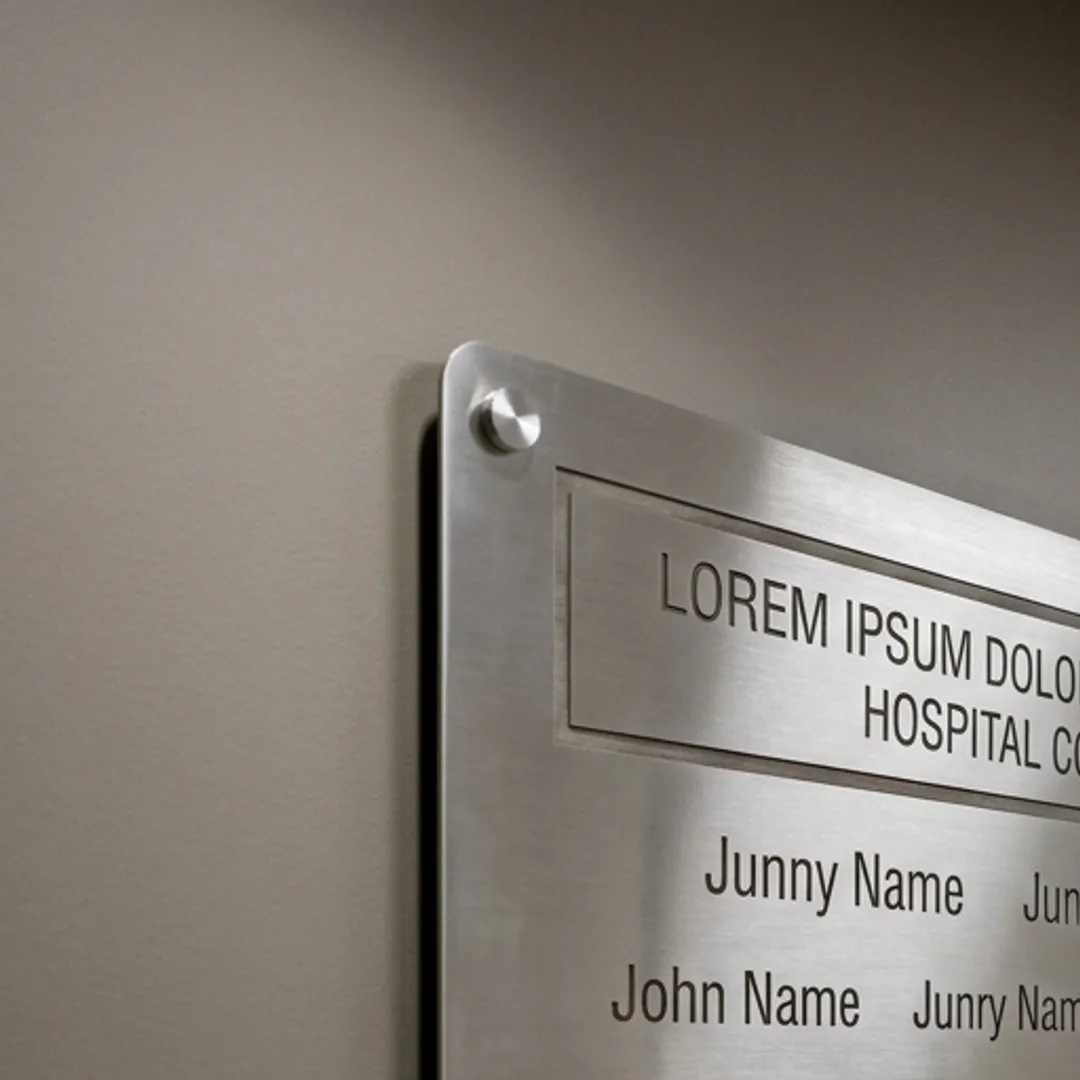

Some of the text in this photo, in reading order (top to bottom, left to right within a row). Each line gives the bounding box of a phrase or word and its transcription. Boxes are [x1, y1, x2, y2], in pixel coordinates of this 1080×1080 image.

[660, 551, 829, 649] LOREM
[845, 598, 972, 681] IPSUM
[863, 683, 1042, 771] HOSPITAL
[704, 834, 964, 919] Junny Name
[610, 963, 861, 1029] John Name
[911, 978, 1008, 1043] Junry
